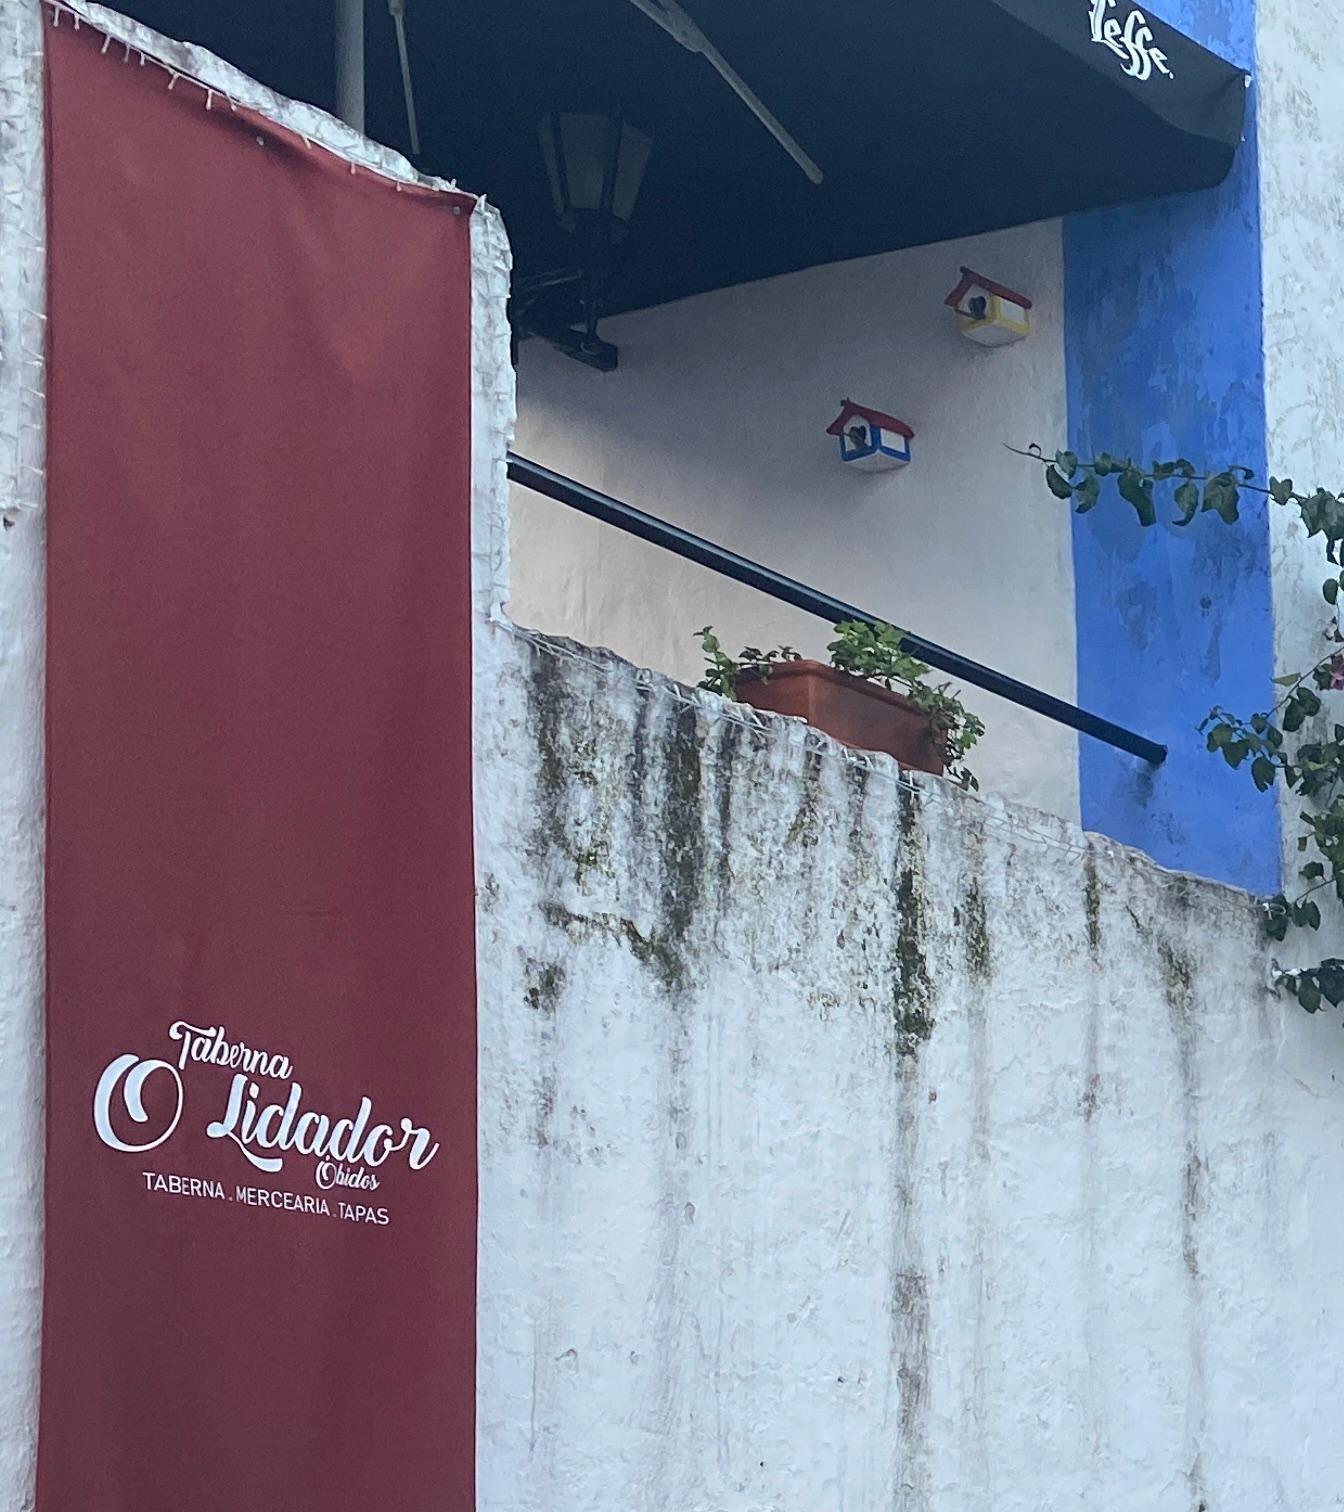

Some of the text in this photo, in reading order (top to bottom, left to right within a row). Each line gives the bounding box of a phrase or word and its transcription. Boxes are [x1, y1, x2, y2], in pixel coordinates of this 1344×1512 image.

[1088, 0, 1171, 80] Leffe
[168, 1019, 293, 1080] Taberna
[93, 1053, 440, 1173] O Lidador
[142, 1171, 390, 1226] TABERNA MERCEARIA TAPAS
[315, 1155, 380, 1190] Óbidos
